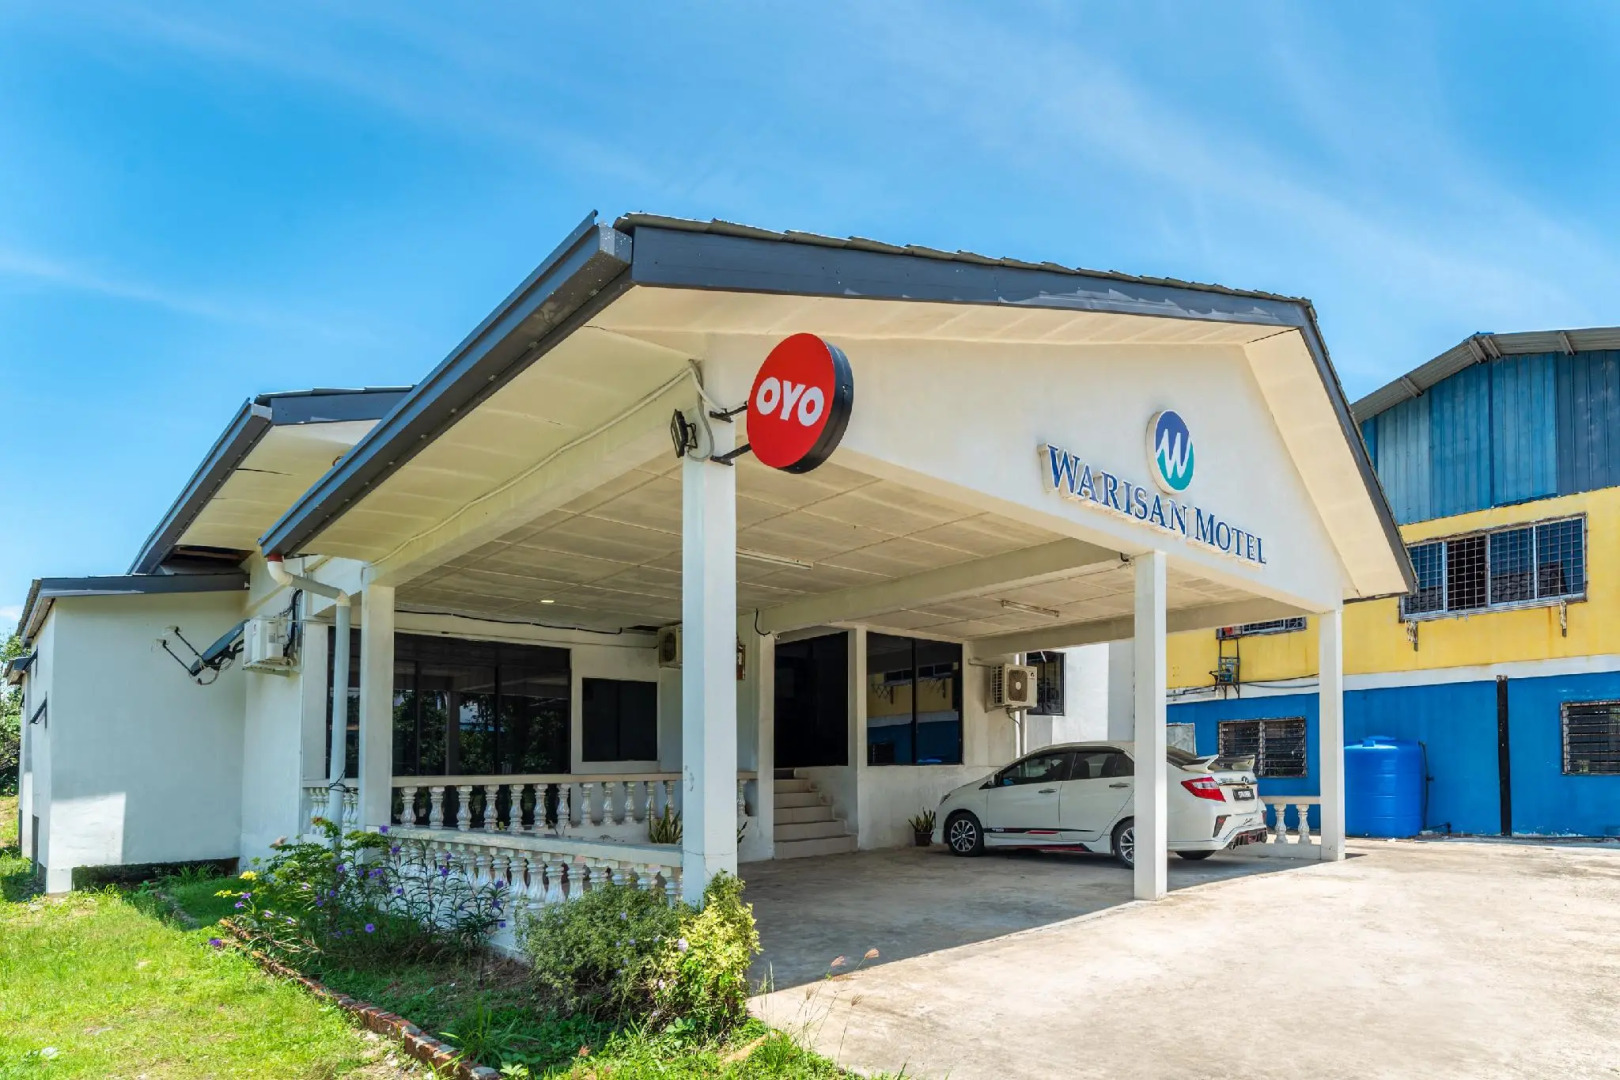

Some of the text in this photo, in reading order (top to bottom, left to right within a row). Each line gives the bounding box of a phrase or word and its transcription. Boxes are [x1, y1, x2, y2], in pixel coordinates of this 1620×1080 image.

[756, 377, 824, 426] OYO
[1047, 444, 1266, 564] WARISAN MOTEL
